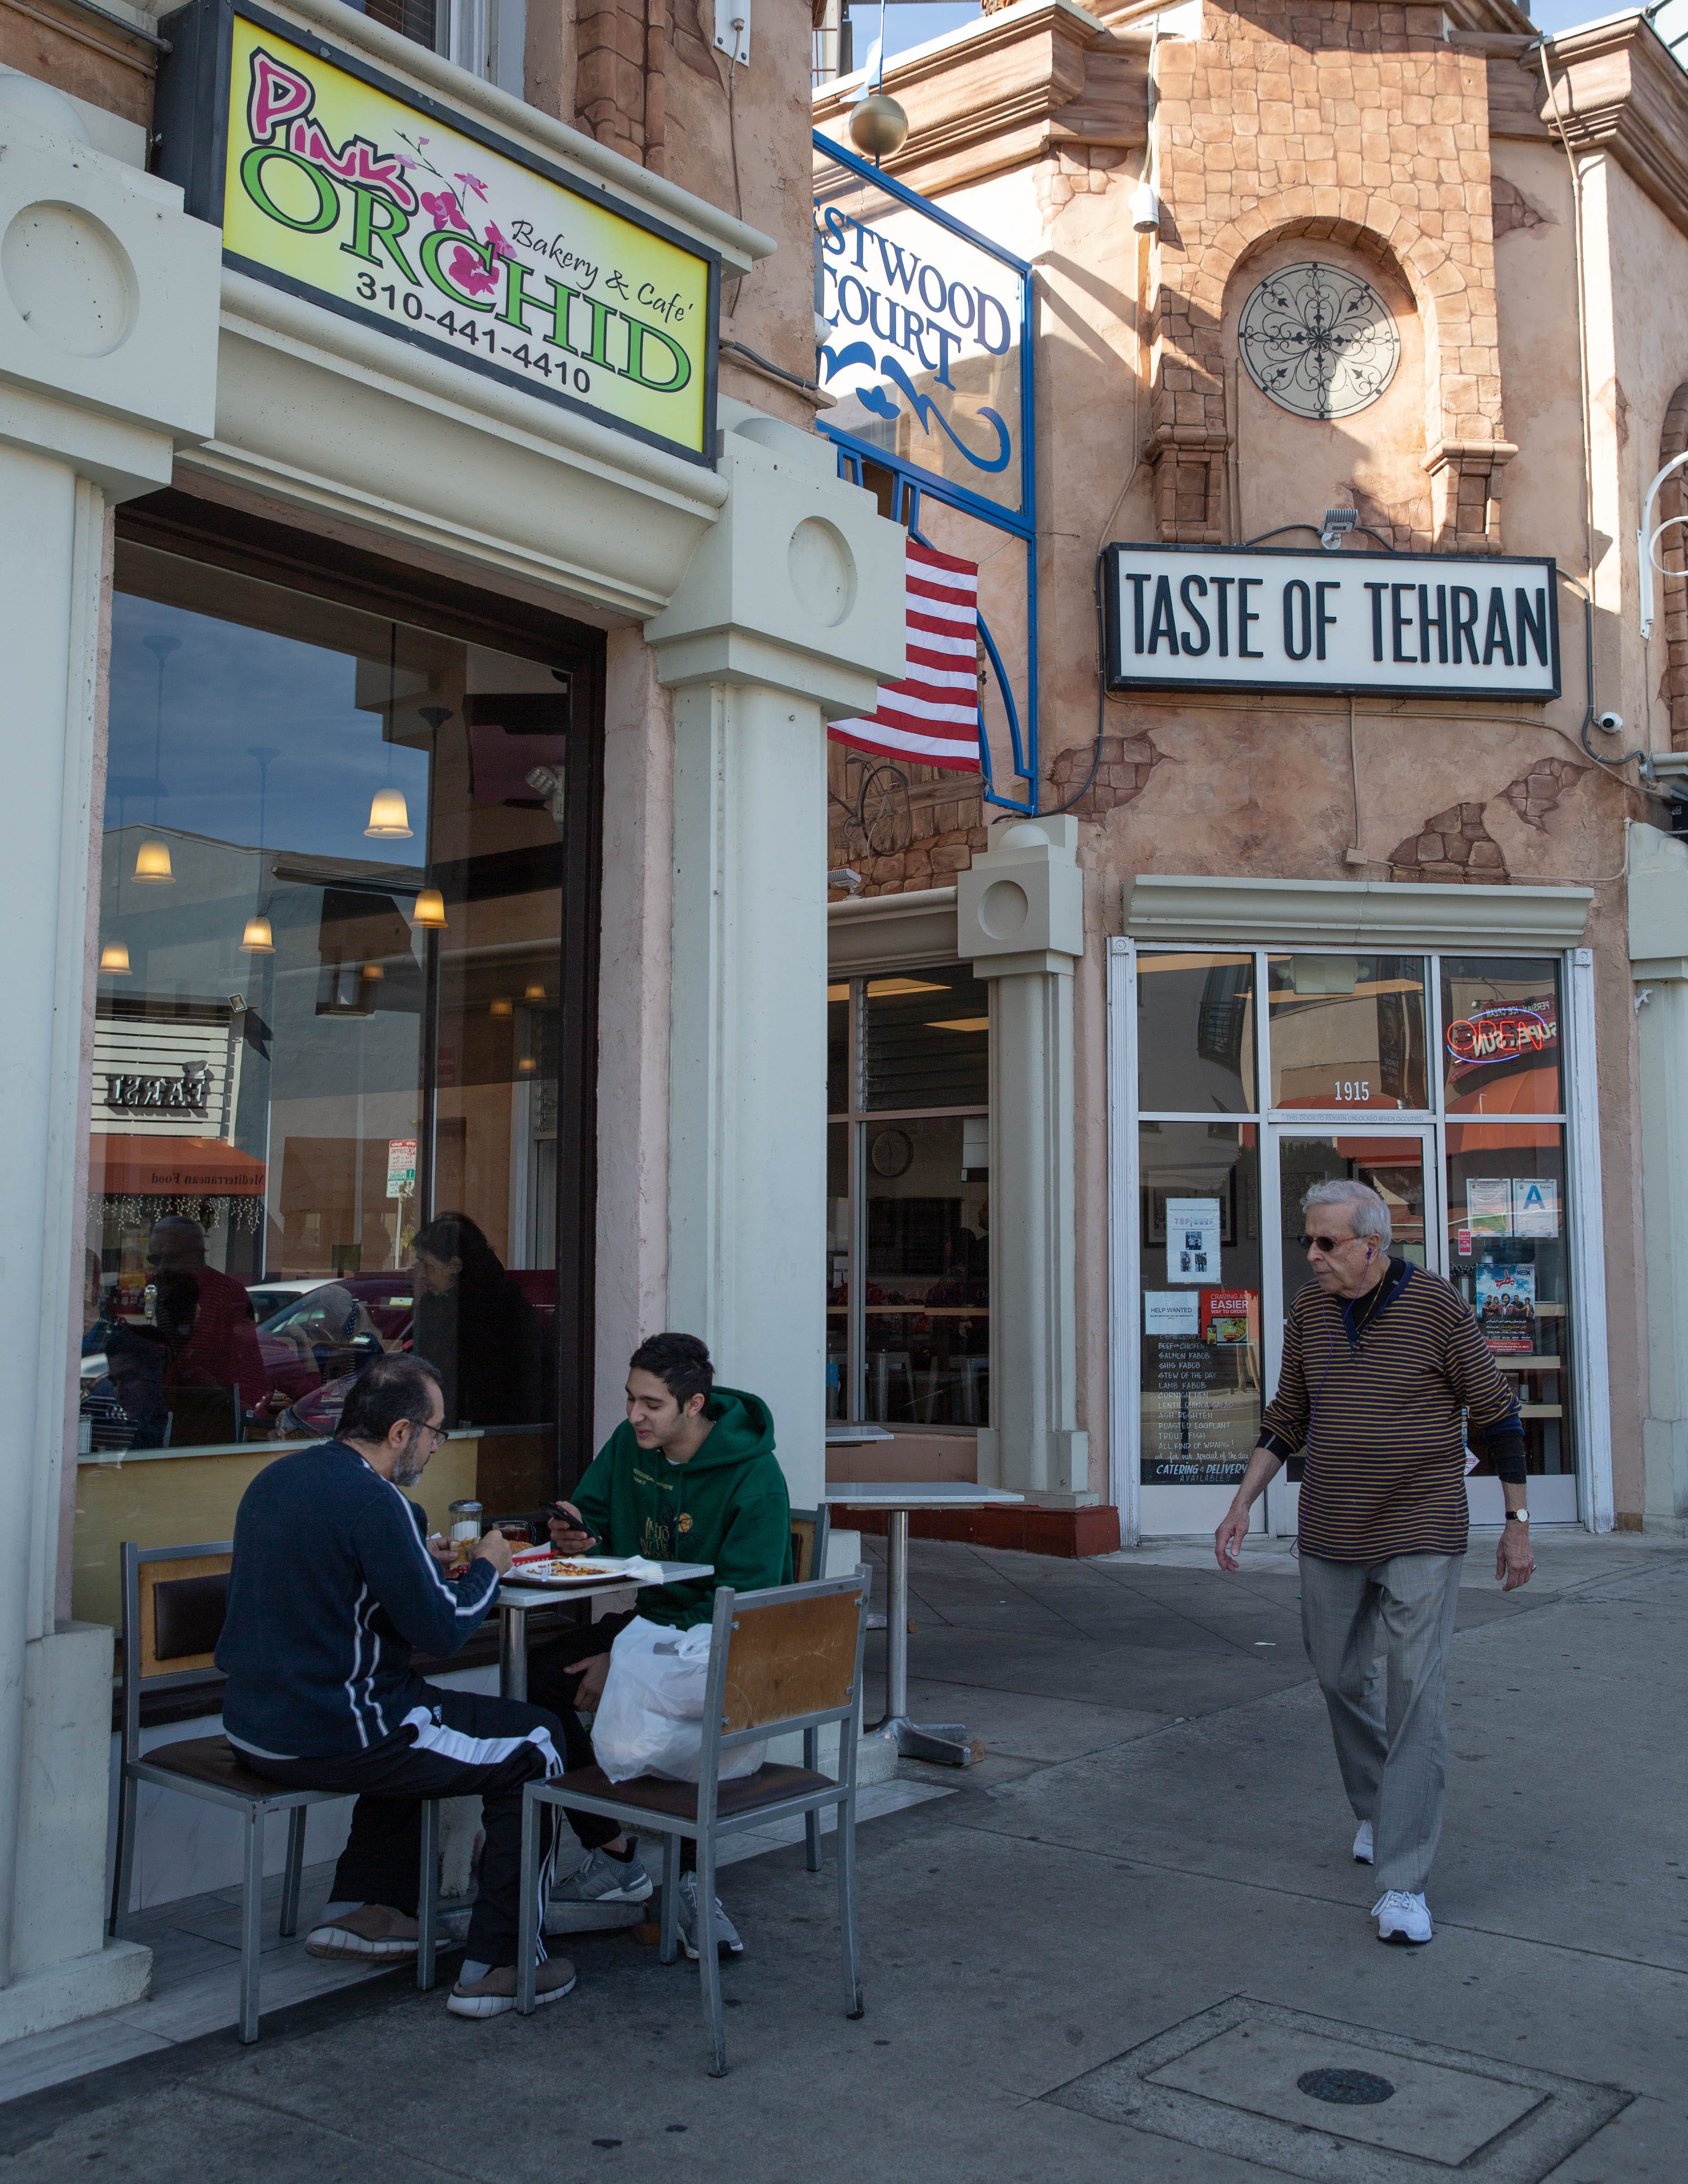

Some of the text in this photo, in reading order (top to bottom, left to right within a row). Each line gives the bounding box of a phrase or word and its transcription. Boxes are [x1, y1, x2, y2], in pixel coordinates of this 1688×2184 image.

[240, 146, 692, 394] ORCHID
[510, 219, 599, 289] Bakery
[606, 270, 630, 301] &
[356, 271, 591, 394] 310-441-4410
[1126, 573, 1548, 666] TASTE OF TEHRAN
[1447, 1019, 1542, 1051] OPEN
[1335, 1081, 1369, 1101] 1915
[1523, 1185, 1545, 1209] A
[1211, 1300, 1249, 1309] EASIER
[1156, 1462, 1199, 1474] CATERING
[1206, 1462, 1249, 1474] DELIVERY
[1167, 1449, 1179, 1463] for
[1195, 1451, 1218, 1463] special
[1220, 1451, 1227, 1462] of
[1228, 1451, 1237, 1460] the
